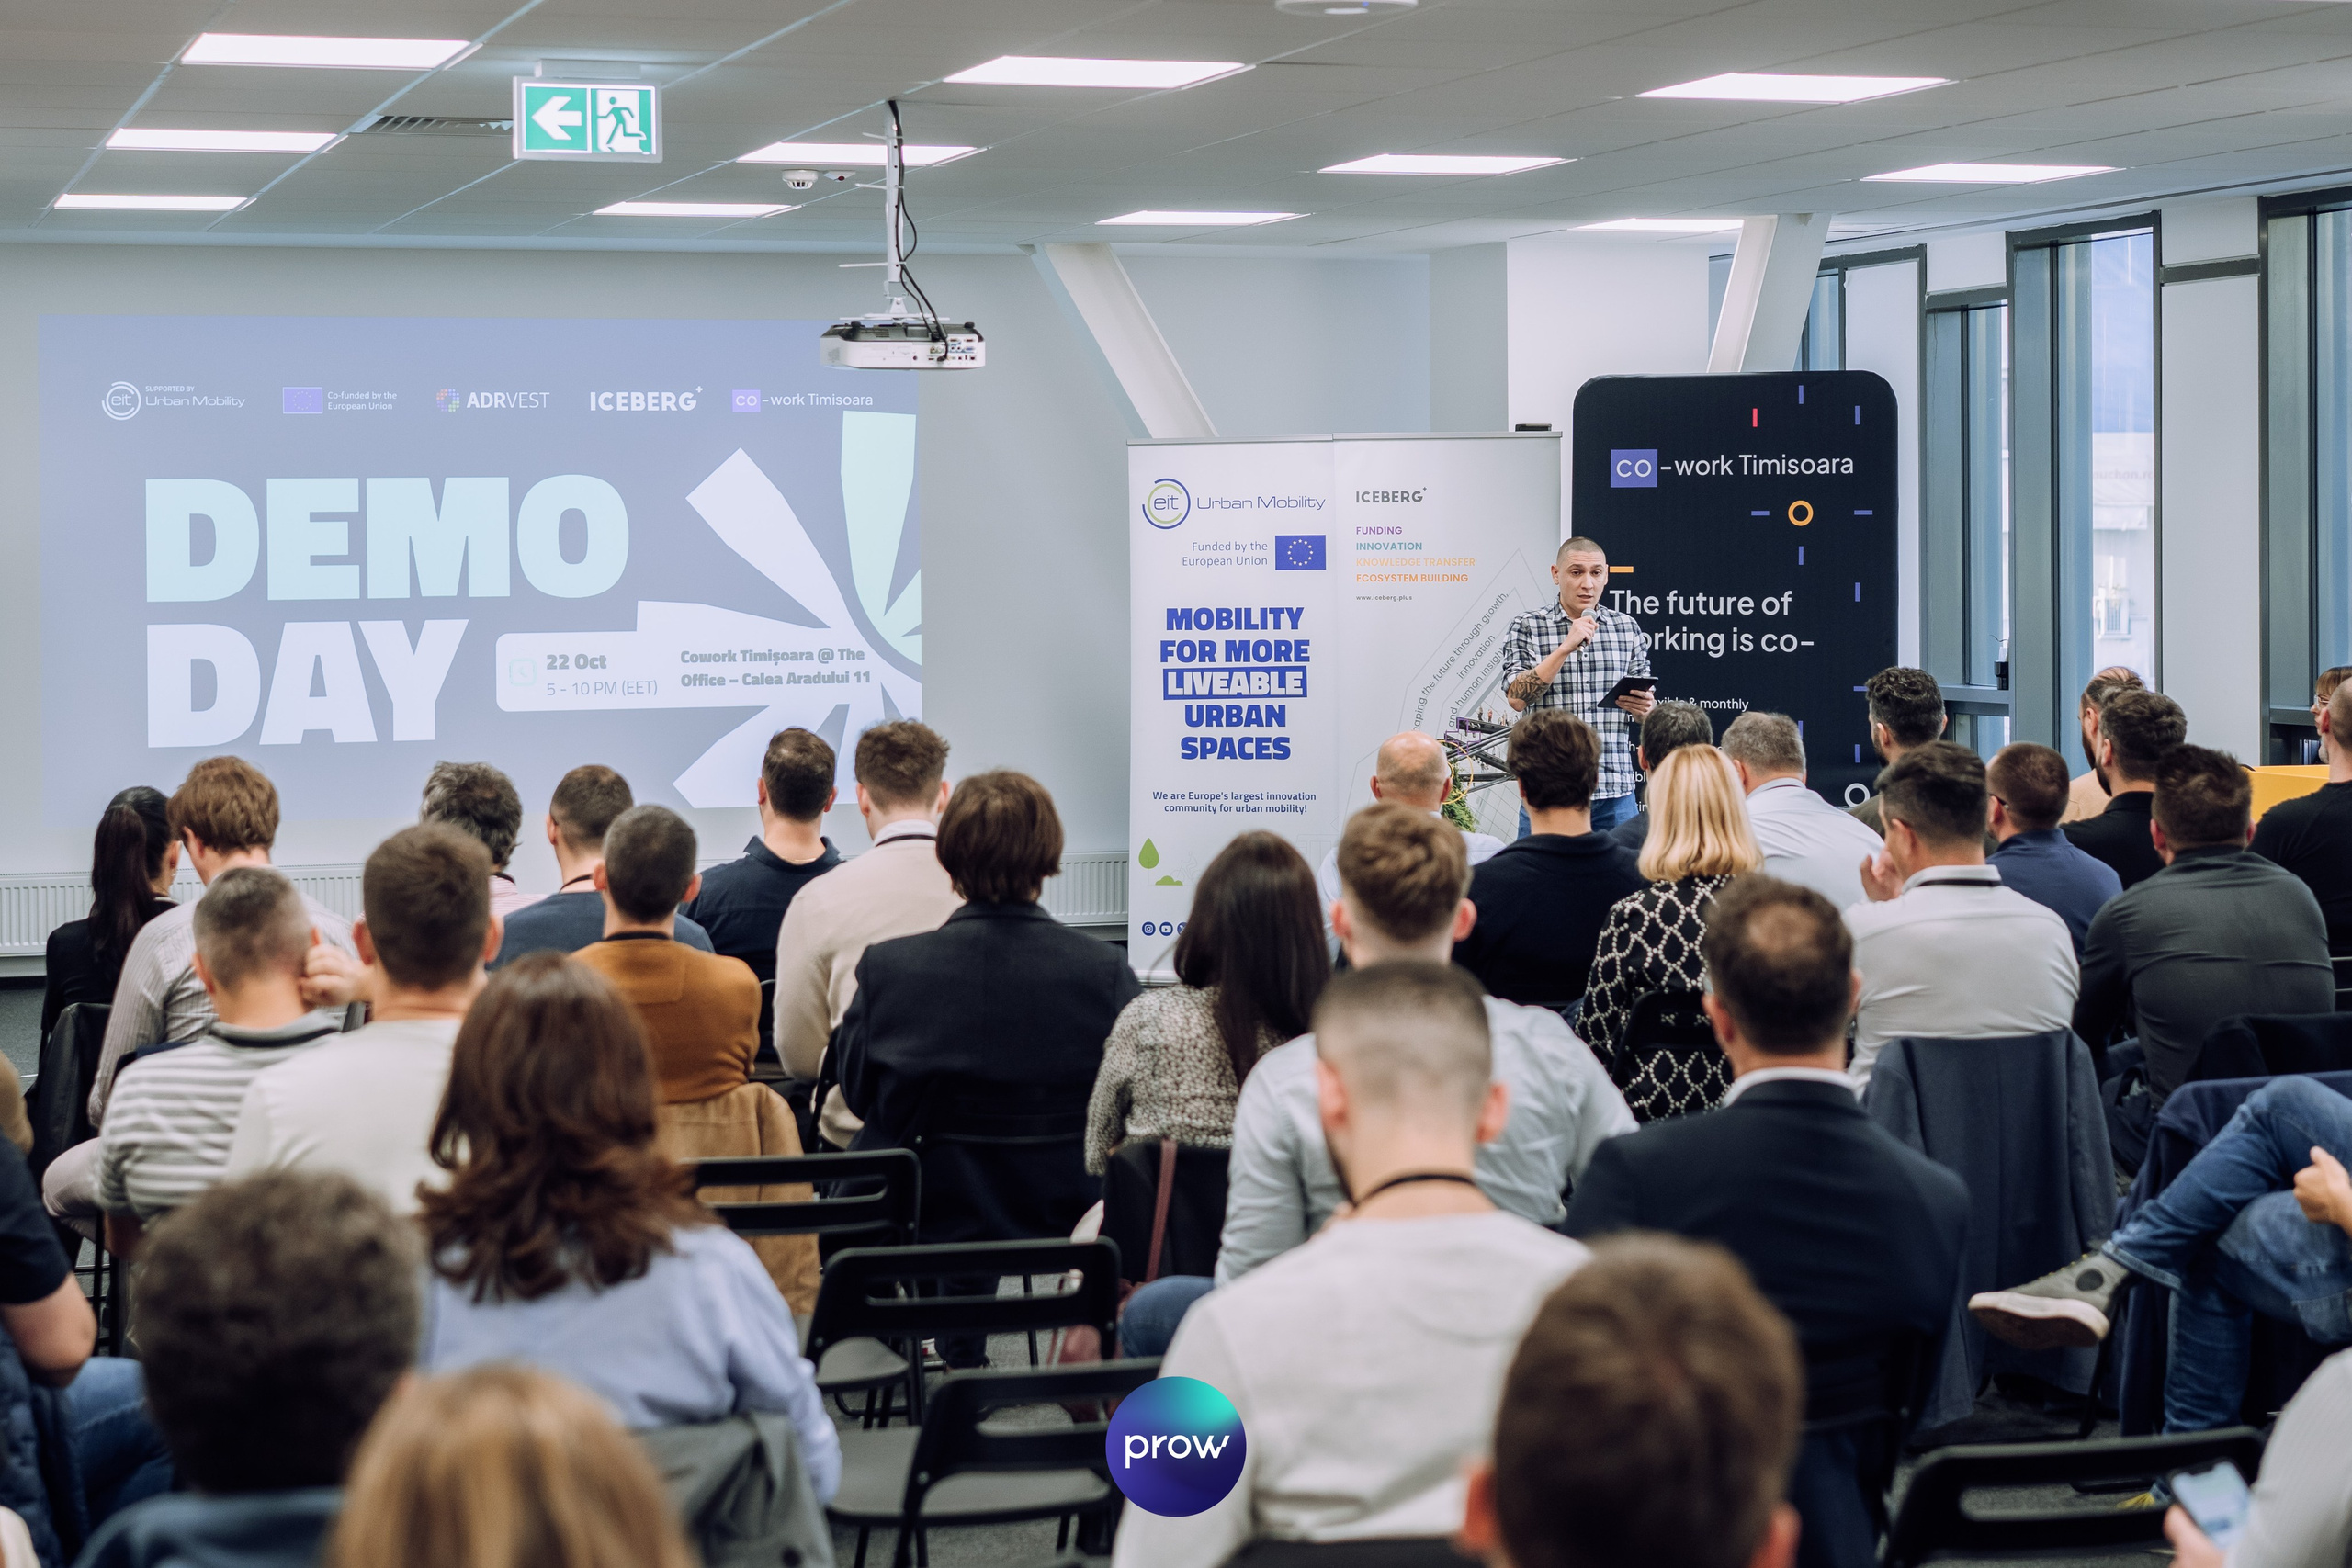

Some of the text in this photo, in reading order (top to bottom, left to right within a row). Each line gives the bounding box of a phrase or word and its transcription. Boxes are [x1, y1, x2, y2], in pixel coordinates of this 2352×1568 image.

[111, 395, 131, 406] eit
[145, 395, 245, 408] Urban Mobility
[327, 391, 397, 401] Co-funded by the
[466, 392, 550, 409] ADRVEST
[808, 393, 874, 407] Timisoara
[328, 401, 392, 412] European Union
[1739, 454, 1854, 475] Timisoara
[1154, 495, 1179, 510] eit
[1197, 495, 1326, 510] Urban Mobility
[145, 474, 629, 602] DEMO
[1356, 526, 1403, 535] FUNDING
[1193, 541, 1268, 553] Funded by the
[1356, 542, 1423, 550] INNOVATION
[1182, 556, 1268, 568] European Union
[1356, 558, 1476, 567] KNOWLEDGE TRANSFER
[1356, 574, 1469, 582] ECOSYSTEM BUILDING
[1609, 590, 1792, 615] The future of
[1166, 607, 1305, 631] MOBILITY
[1422, 680, 1436, 696] the
[1433, 655, 1456, 682] future
[1453, 622, 1483, 656] through
[1482, 592, 1510, 625] growth,
[1641, 626, 1724, 658] orking
[1733, 627, 1754, 652] is
[680, 648, 865, 666] Cowork Timișoara @ The
[1160, 639, 1310, 662] FOR MORE
[1456, 634, 1496, 680] innovation
[547, 653, 606, 670] 22 Oct
[147, 619, 469, 748] DAY
[681, 673, 726, 687] Office
[741, 672, 783, 686] Calea
[786, 671, 850, 685] Aradului
[853, 671, 871, 683] 11
[1167, 671, 1303, 695] LIVEABLE
[547, 682, 556, 695] 5
[571, 682, 590, 695] 10
[594, 681, 617, 695] PM
[621, 680, 658, 697] (EET)
[1448, 706, 1458, 728] and
[1455, 676, 1483, 707] human
[1700, 698, 1749, 712] monthly
[1184, 705, 1286, 728] URBAN
[1181, 736, 1291, 760] SPACES
[1152, 791, 1169, 800] We
[1188, 791, 1228, 802] Europe's
[1231, 791, 1264, 802] largest
[1266, 792, 1317, 801] innovation
[1164, 804, 1307, 815] community for urban mobility!
